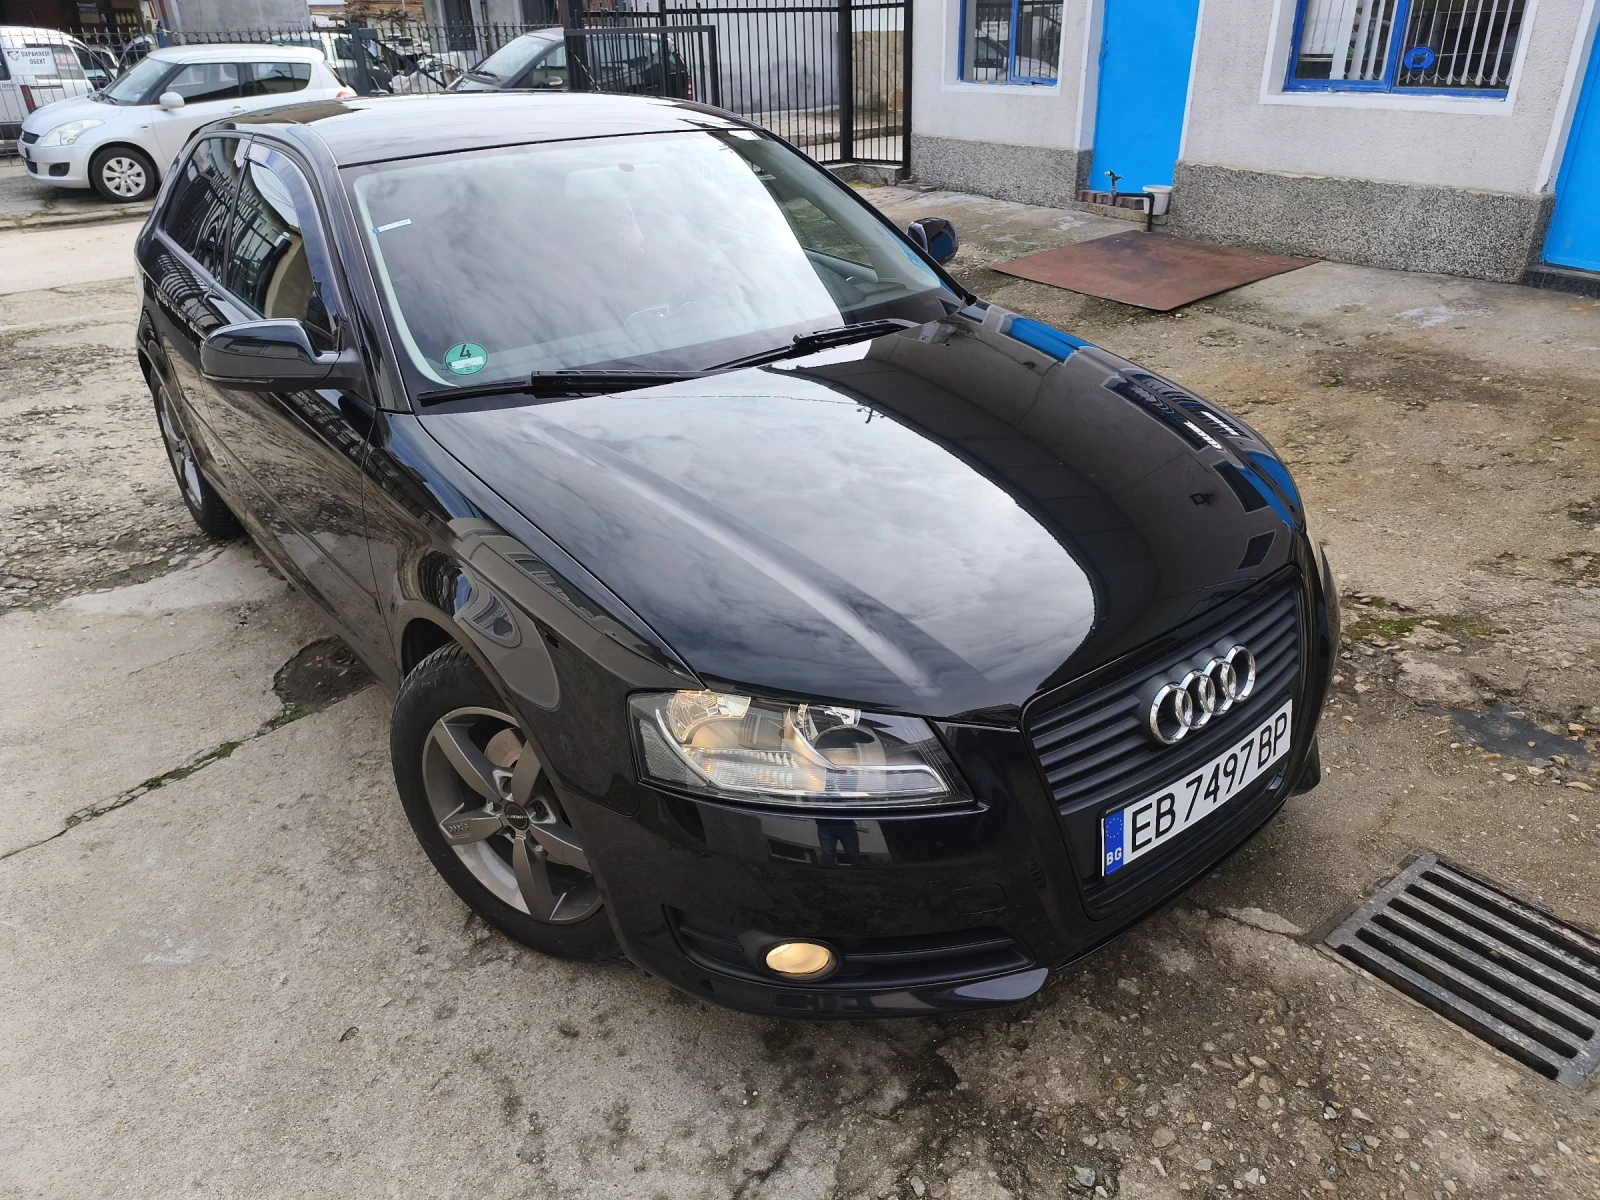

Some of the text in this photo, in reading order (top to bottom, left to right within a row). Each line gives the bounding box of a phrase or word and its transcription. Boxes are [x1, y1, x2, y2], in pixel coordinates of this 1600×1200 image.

[460, 344, 472, 358] 4
[1131, 711, 1288, 854] EB 7497 BP
[1106, 846, 1122, 866] BG
